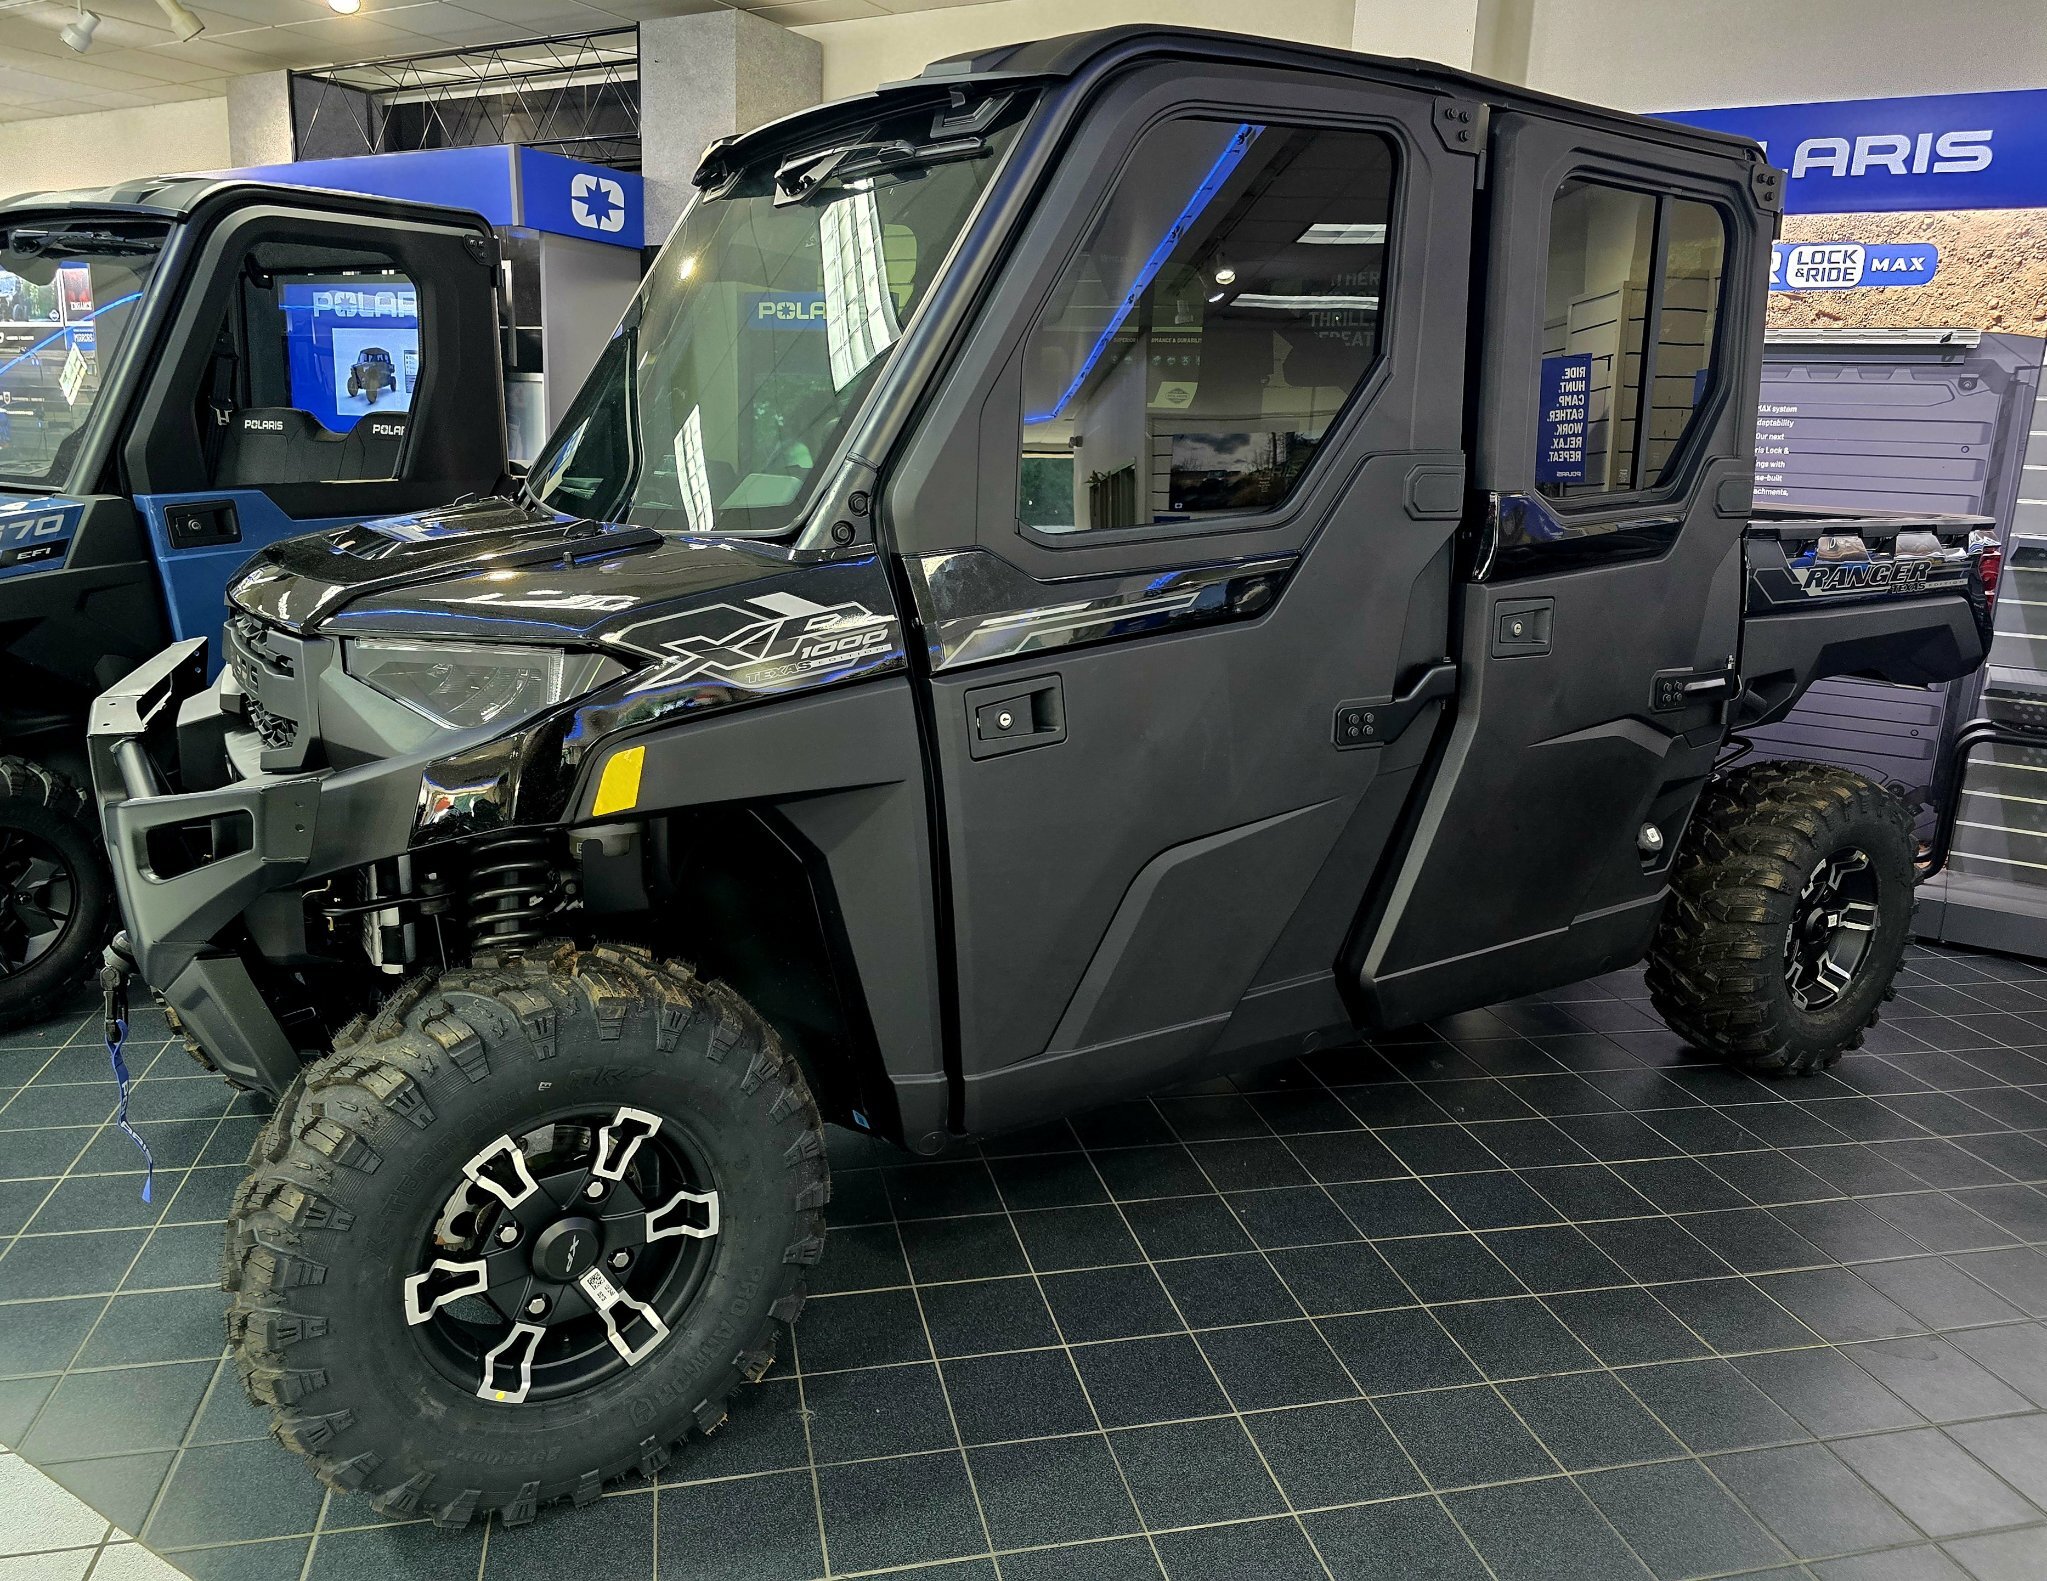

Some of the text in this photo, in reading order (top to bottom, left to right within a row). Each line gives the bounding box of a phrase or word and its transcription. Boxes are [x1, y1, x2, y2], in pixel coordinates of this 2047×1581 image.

[1797, 249, 1858, 265] LOCK
[1871, 257, 1926, 272] MAX
[758, 301, 827, 319] POLA
[1772, 406, 1798, 414] system
[244, 419, 284, 431] POLARIS
[1755, 432, 1768, 440] Our
[1765, 446, 1783, 454] Lock
[1783, 447, 1790, 455] &
[1755, 459, 1786, 469] ngs with
[1755, 474, 1783, 482] se-built
[0, 514, 65, 541] 70
[17, 547, 51, 560] EFI
[1801, 561, 1932, 591] RANGER
[1890, 582, 1926, 594] TEXAS
[801, 629, 889, 660] 1000
[746, 661, 813, 684] TEXAS
